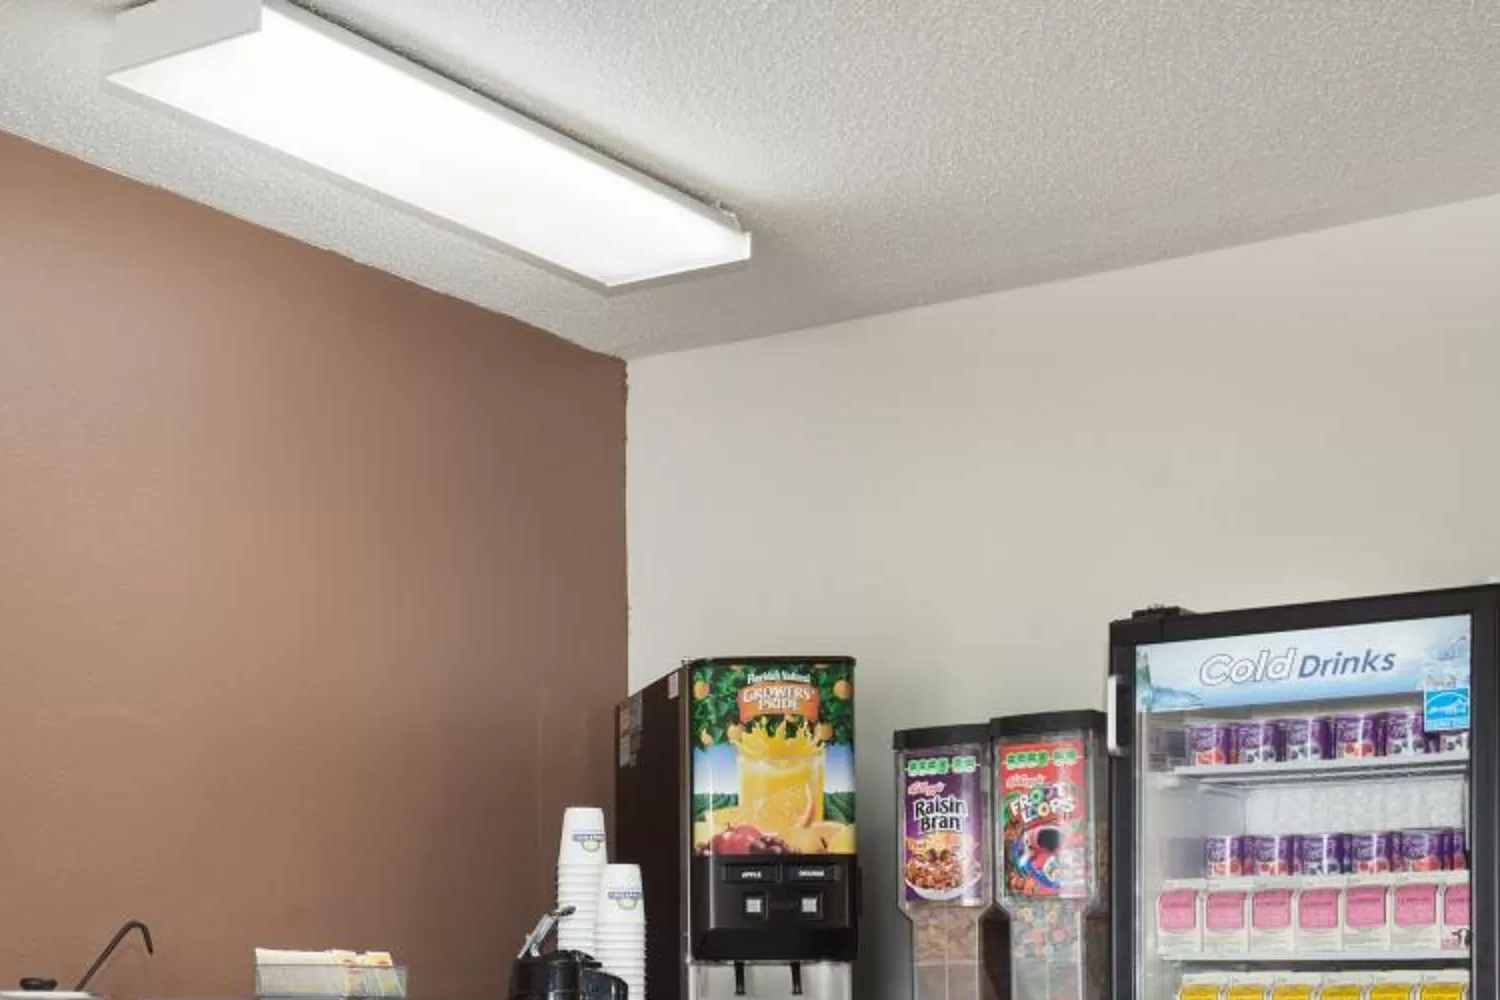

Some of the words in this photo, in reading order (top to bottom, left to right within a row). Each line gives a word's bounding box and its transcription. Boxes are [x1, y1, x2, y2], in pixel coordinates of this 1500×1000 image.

[1200, 648, 1298, 686] Cold
[1300, 650, 1396, 678] Drinks
[915, 796, 967, 819] Raisin
[920, 815, 961, 832] Bran
